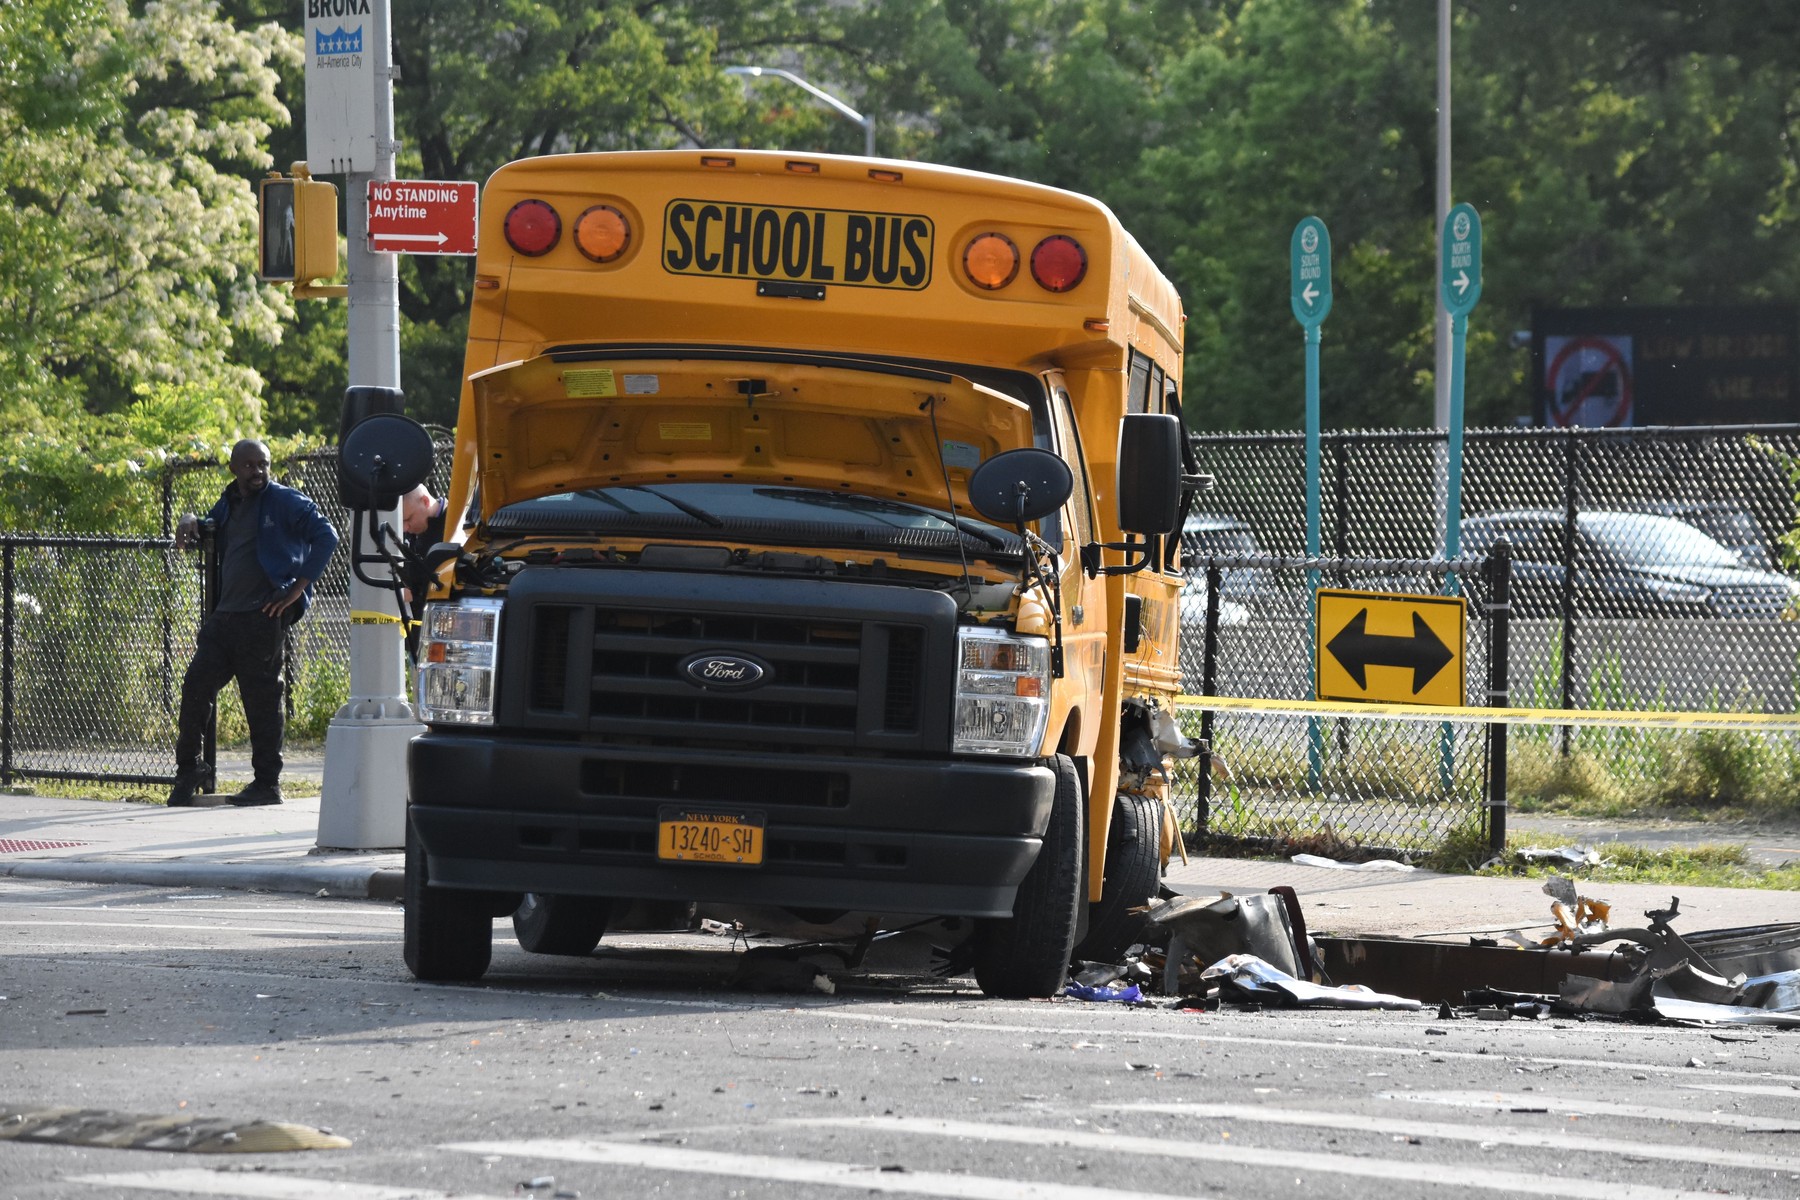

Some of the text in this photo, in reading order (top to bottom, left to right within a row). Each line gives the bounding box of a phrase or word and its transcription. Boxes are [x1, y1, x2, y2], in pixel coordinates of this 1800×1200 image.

[308, 0, 371, 18] BRONX
[317, 54, 363, 69] All-America City
[374, 188, 459, 203] NO STANDING
[374, 204, 427, 221] Anytime
[667, 203, 929, 287] SCHOOL BUS
[1301, 254, 1320, 267] SOUTH
[1300, 266, 1321, 280] BOUND
[704, 660, 745, 680] Ford
[686, 813, 739, 824] NEW YORK
[693, 852, 727, 861] SCHOOL
